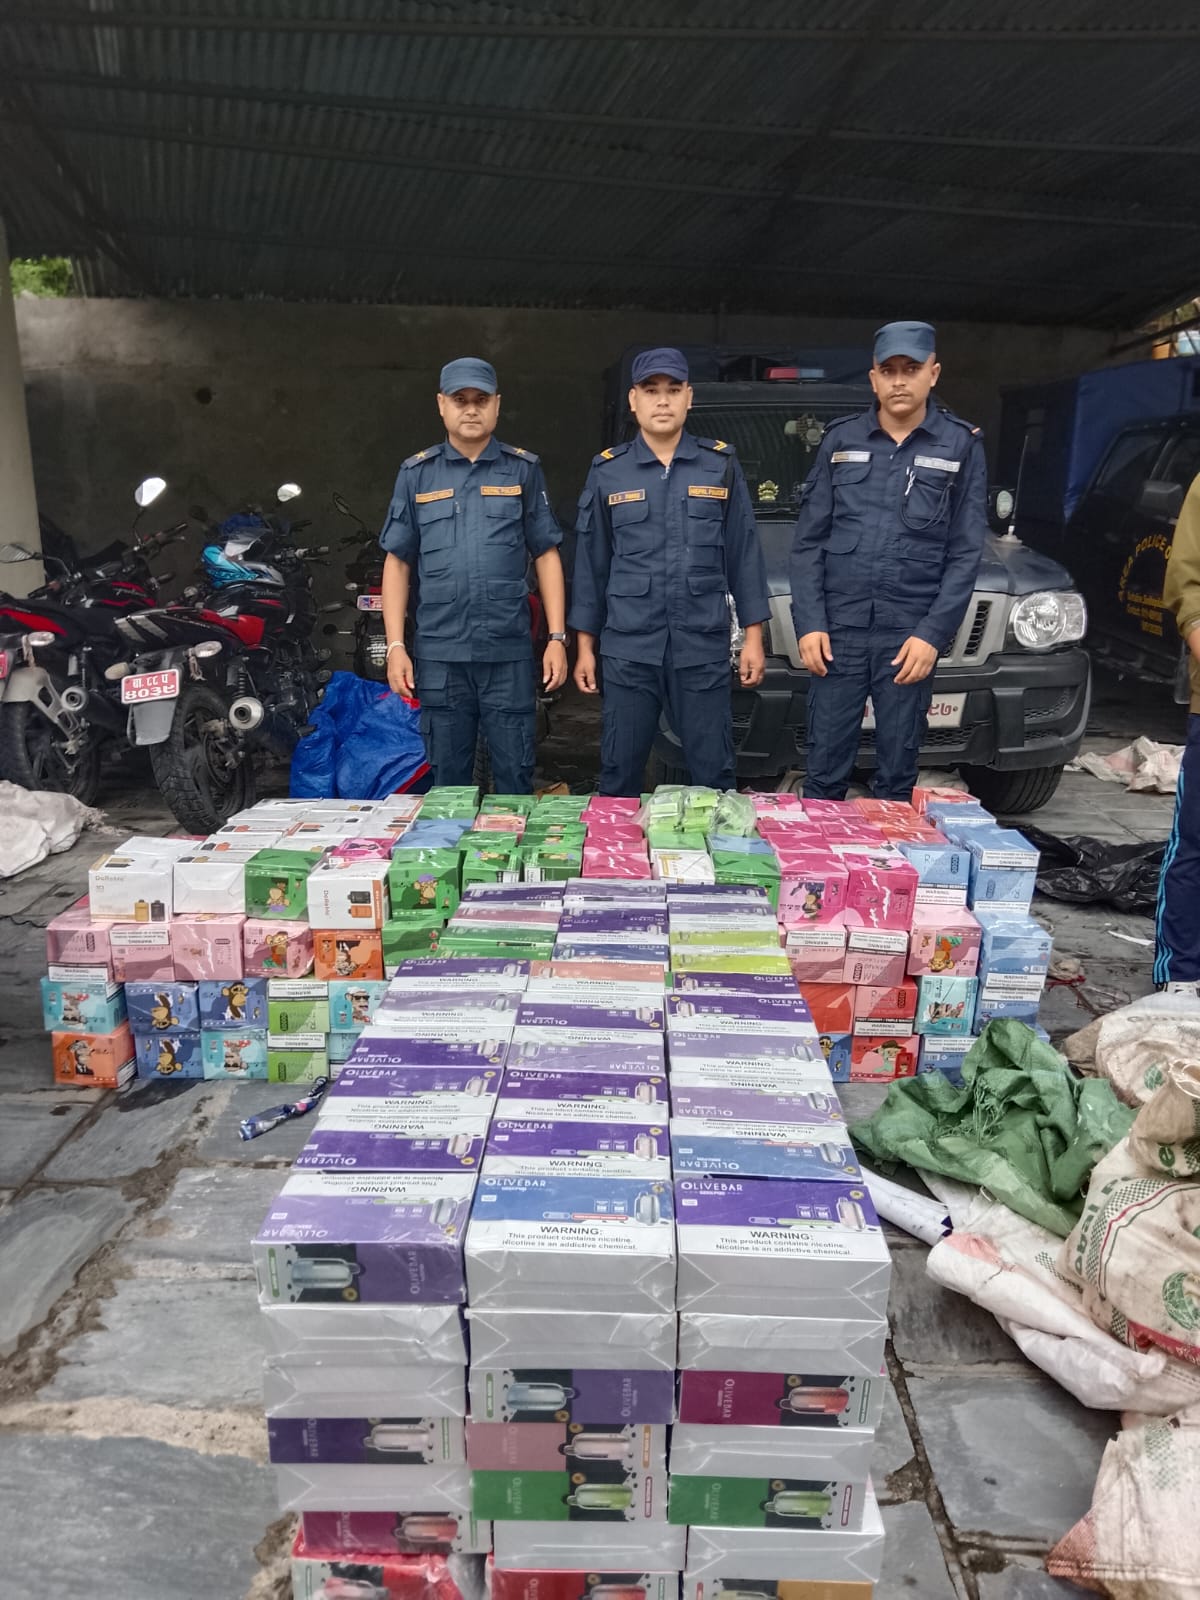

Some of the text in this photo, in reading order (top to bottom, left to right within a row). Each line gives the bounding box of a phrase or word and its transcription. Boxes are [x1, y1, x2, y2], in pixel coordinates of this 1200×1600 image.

[510, 1071, 562, 1079] OLIVEBAR
[496, 1121, 553, 1130] OLIVEBAR
[297, 1157, 358, 1166] OLIVEBAR
[679, 1161, 740, 1170] OLIVEBAR
[484, 1178, 547, 1187] OLIVEBAR
[681, 1182, 743, 1192] OLIVEBAR
[262, 1229, 329, 1239] OLIVEBAR
[540, 1226, 603, 1236] WARNING:
[750, 1230, 814, 1240] WARNING:
[740, 1238, 772, 1246] product
[774, 1246, 811, 1254] addictive
[408, 1249, 420, 1294] OLIVEBAR
[621, 1377, 632, 1417] OLIVEBAR
[723, 1378, 736, 1419] OLIVEBAR
